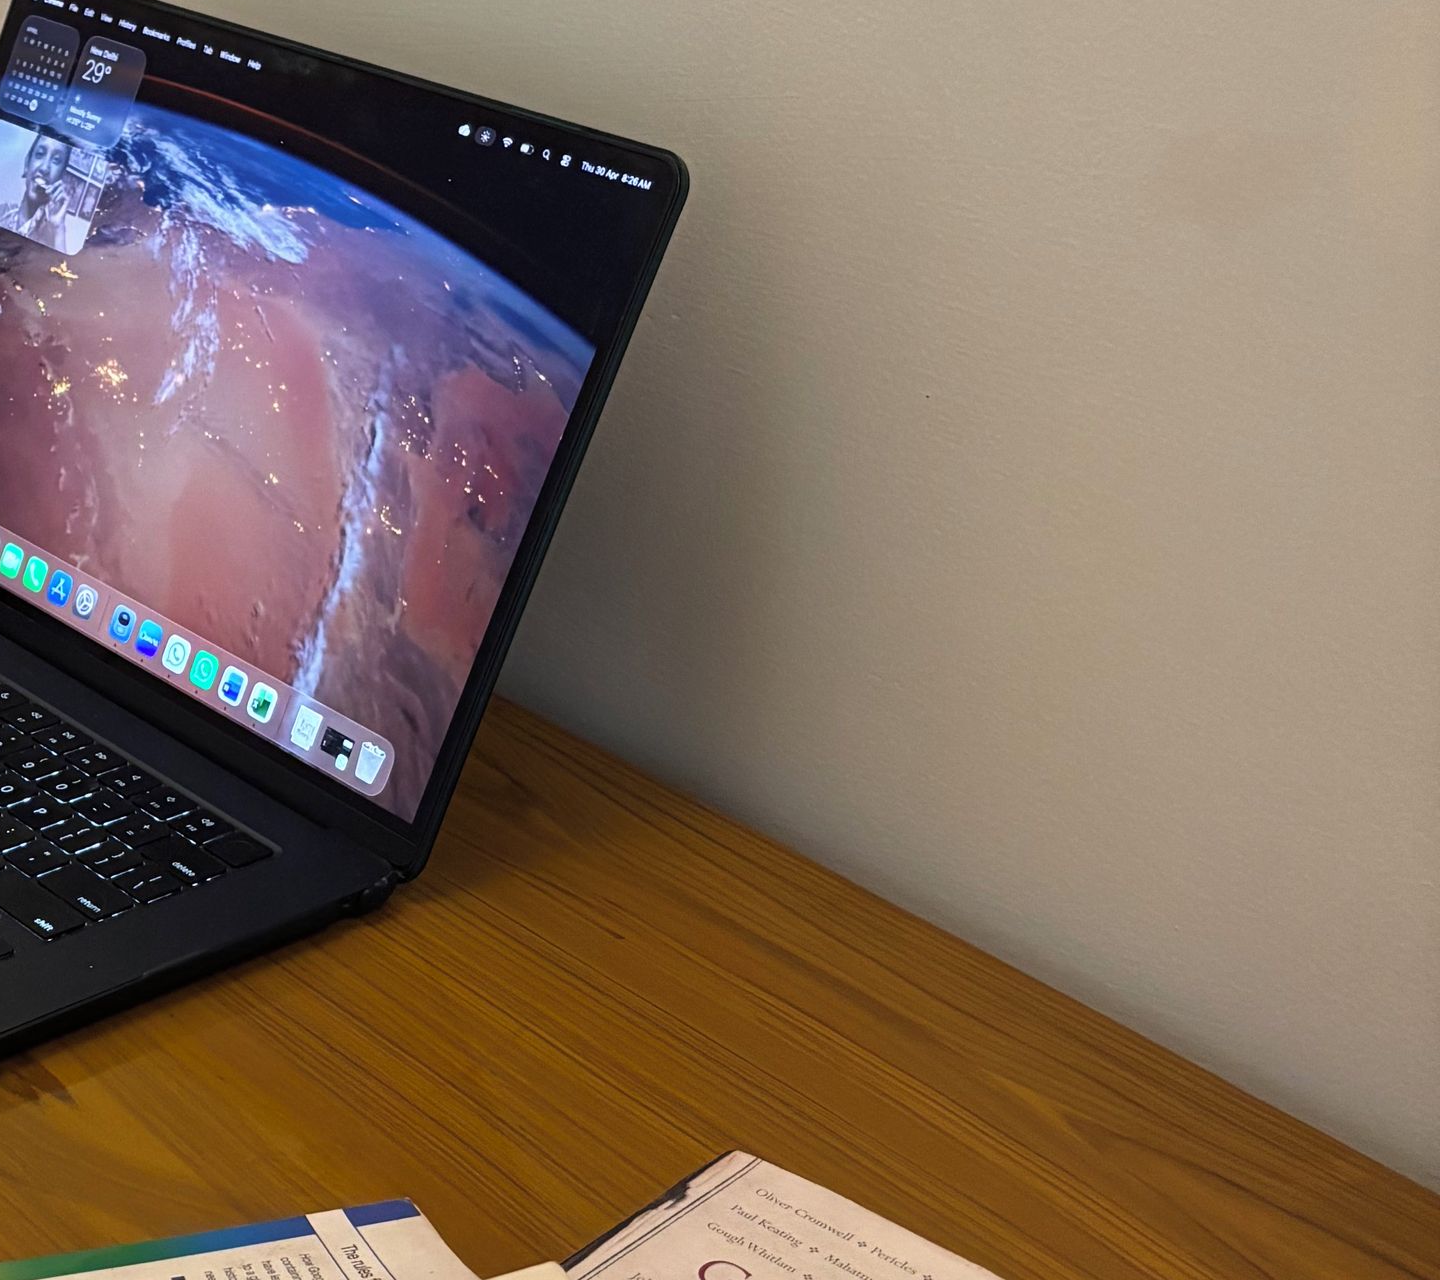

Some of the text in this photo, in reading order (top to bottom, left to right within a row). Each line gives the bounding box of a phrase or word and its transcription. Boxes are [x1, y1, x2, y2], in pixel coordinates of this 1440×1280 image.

[68, 3, 79, 12] File
[83, 7, 95, 17] Edit
[100, 13, 113, 23] View
[118, 19, 137, 32] History
[142, 26, 170, 41] Bookmarks
[175, 36, 196, 49] Profiles
[219, 50, 241, 63] Window
[247, 59, 261, 70] Help
[89, 45, 119, 61] New Delhi
[81, 58, 112, 83] 29°
[582, 160, 595, 173] Thu
[594, 165, 606, 176] 30
[604, 169, 619, 180] Apr
[171, 861, 195, 876] delete
[77, 896, 100, 912] return
[33, 918, 53, 931] shift
[729, 1204, 759, 1221] Paul
[757, 1218, 803, 1248] Keating
[755, 1188, 793, 1210] Oliver
[794, 1208, 855, 1241] Cromwell
[869, 1246, 917, 1275] Pericles
[706, 1222, 745, 1246] Gough
[747, 1241, 796, 1273] Whitlam
[340, 1243, 359, 1260] The
[350, 1259, 373, 1279] rules
